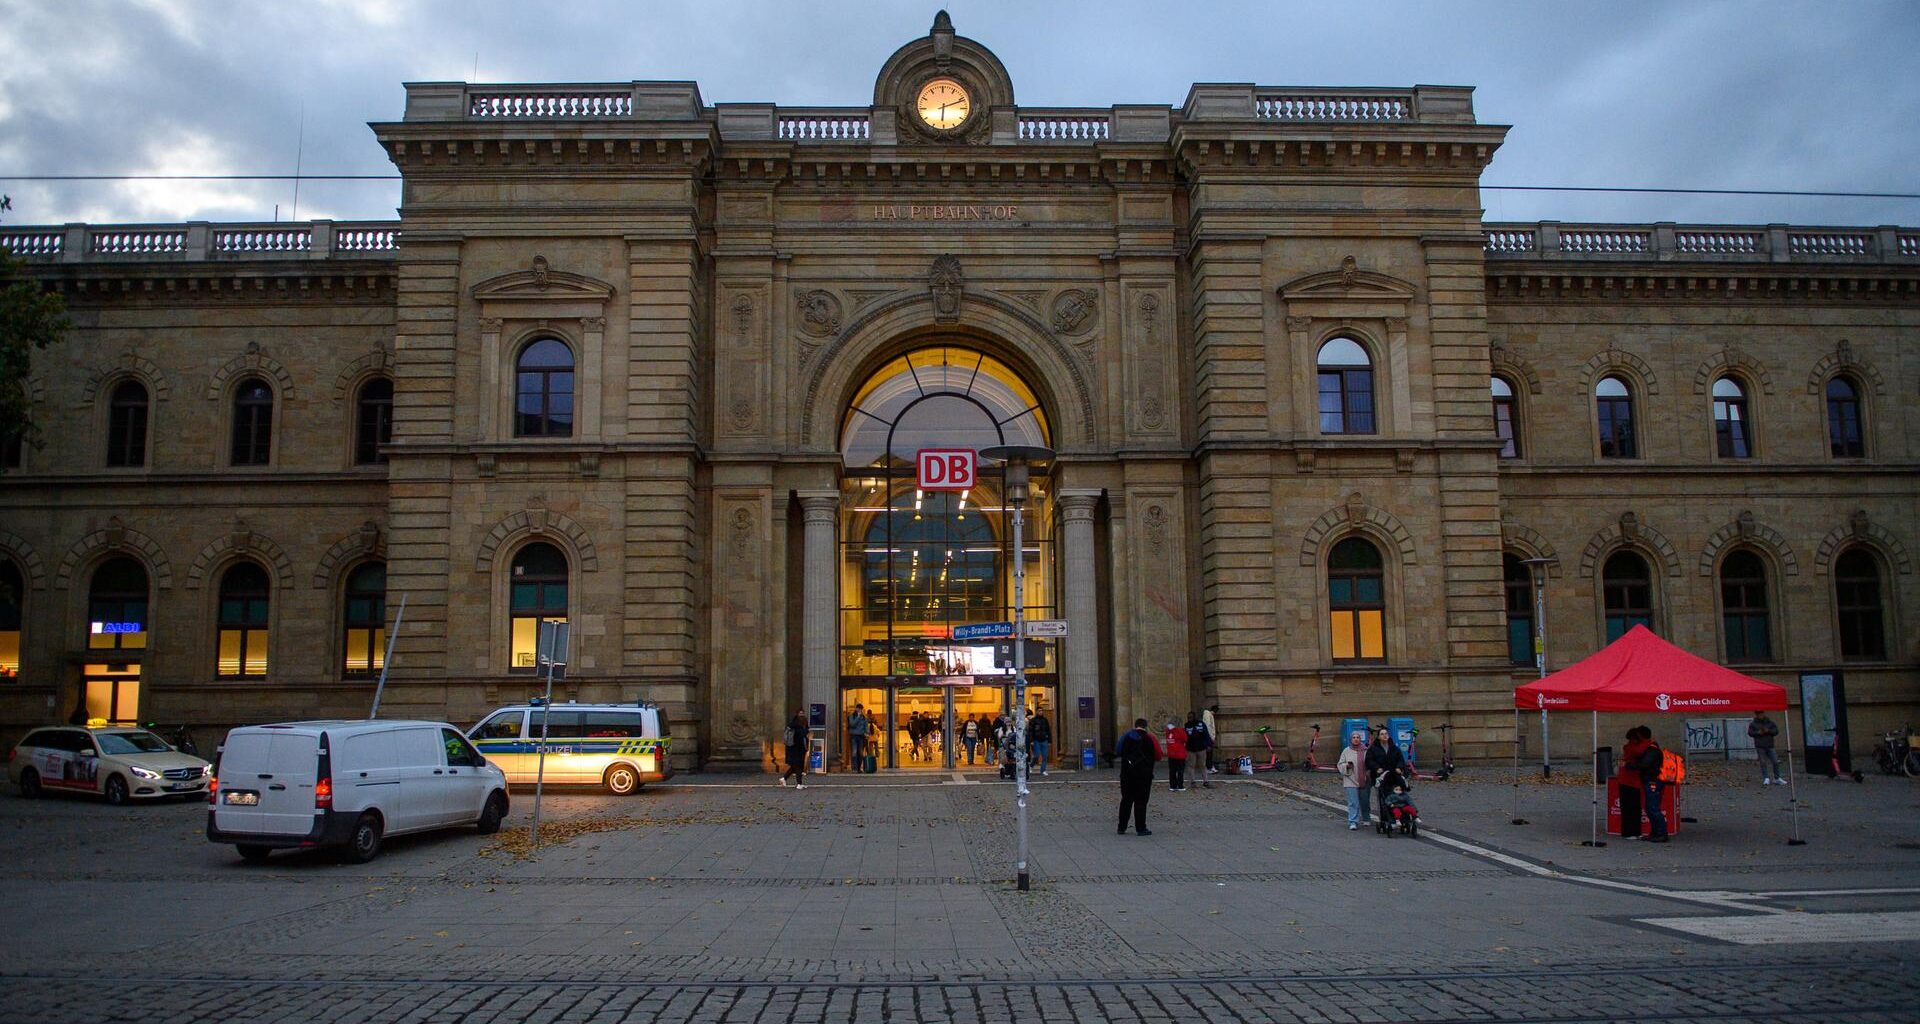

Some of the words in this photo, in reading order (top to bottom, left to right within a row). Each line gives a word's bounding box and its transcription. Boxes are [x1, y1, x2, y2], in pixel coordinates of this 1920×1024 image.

[873, 205, 1018, 220] HAUPTBAHNHOF
[925, 456, 970, 484] DB
[103, 622, 141, 633] ALDI
[954, 624, 1011, 638] Willy-Brandt-Platz
[1672, 698, 1688, 706] Save
[536, 745, 573, 754] POLIZEI
